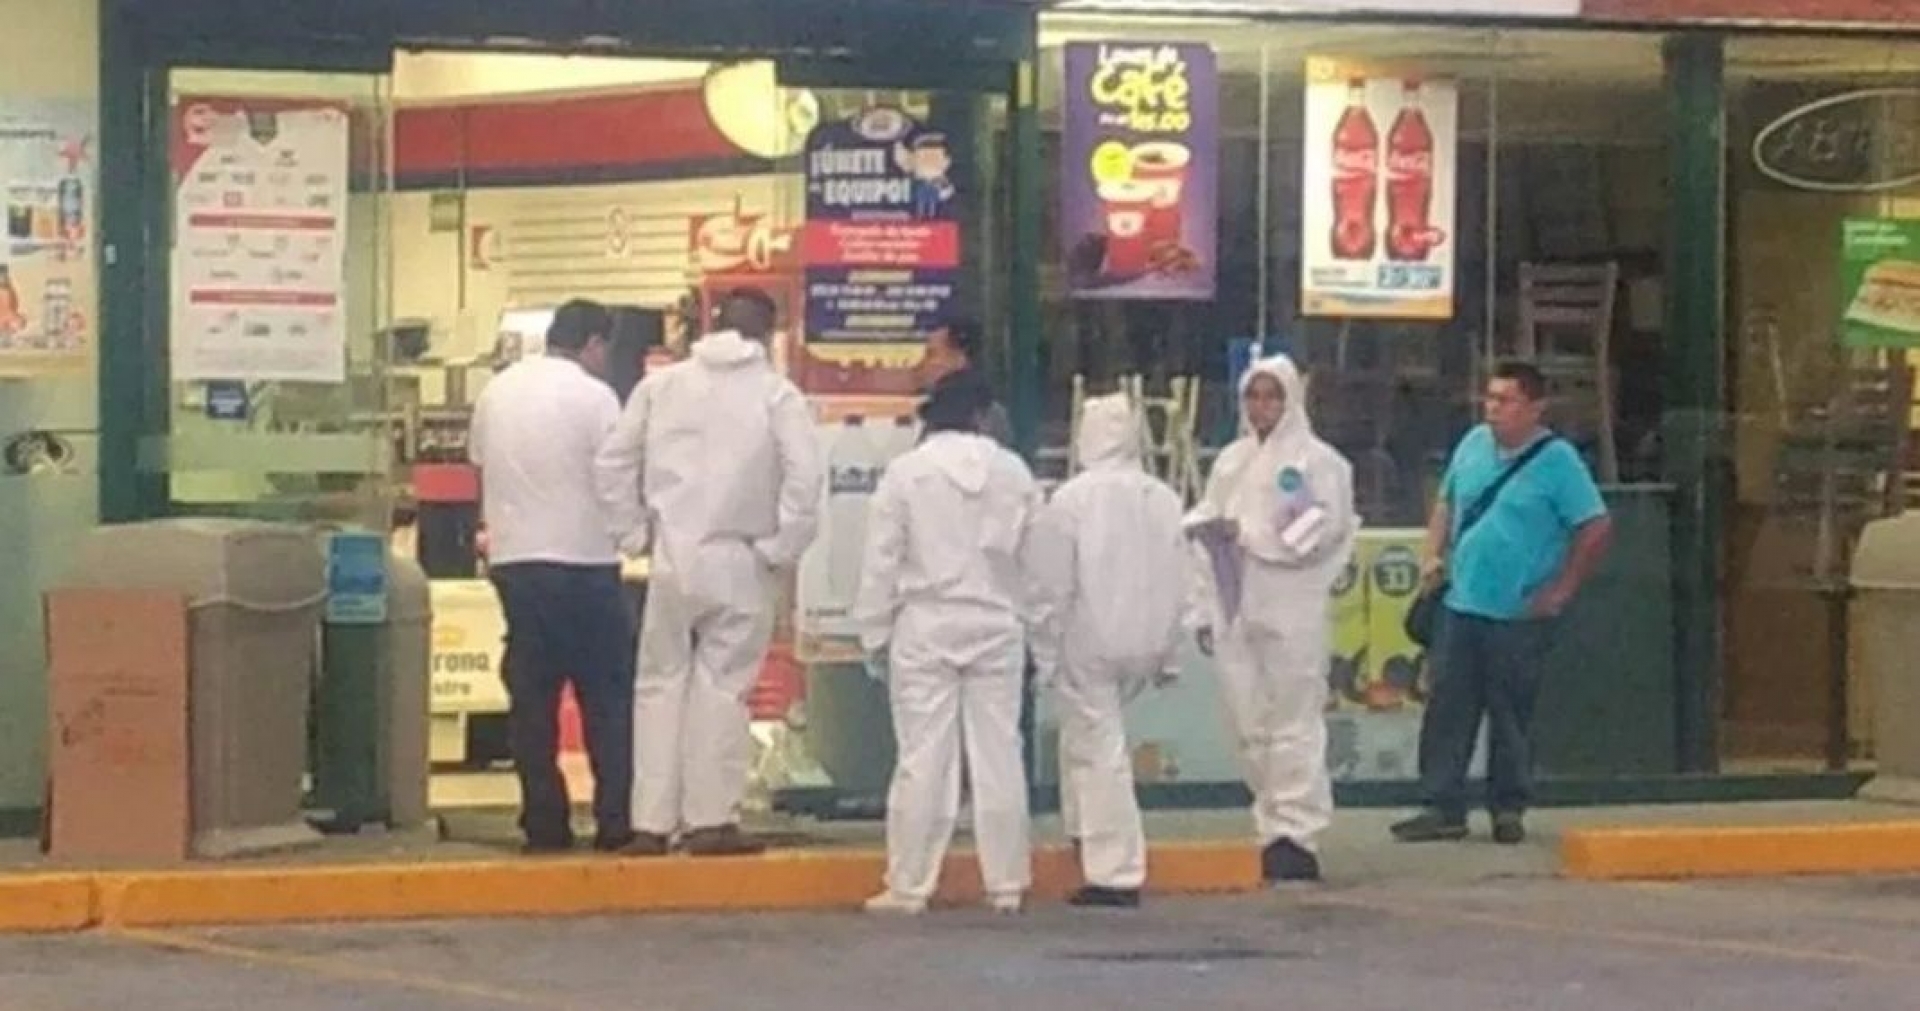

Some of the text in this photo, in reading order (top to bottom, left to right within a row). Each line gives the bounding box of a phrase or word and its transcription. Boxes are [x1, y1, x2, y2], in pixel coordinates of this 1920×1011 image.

[1091, 60, 1187, 112] Café
[810, 144, 885, 176] ¡ÚNETE
[823, 178, 911, 207] EQUIPO!
